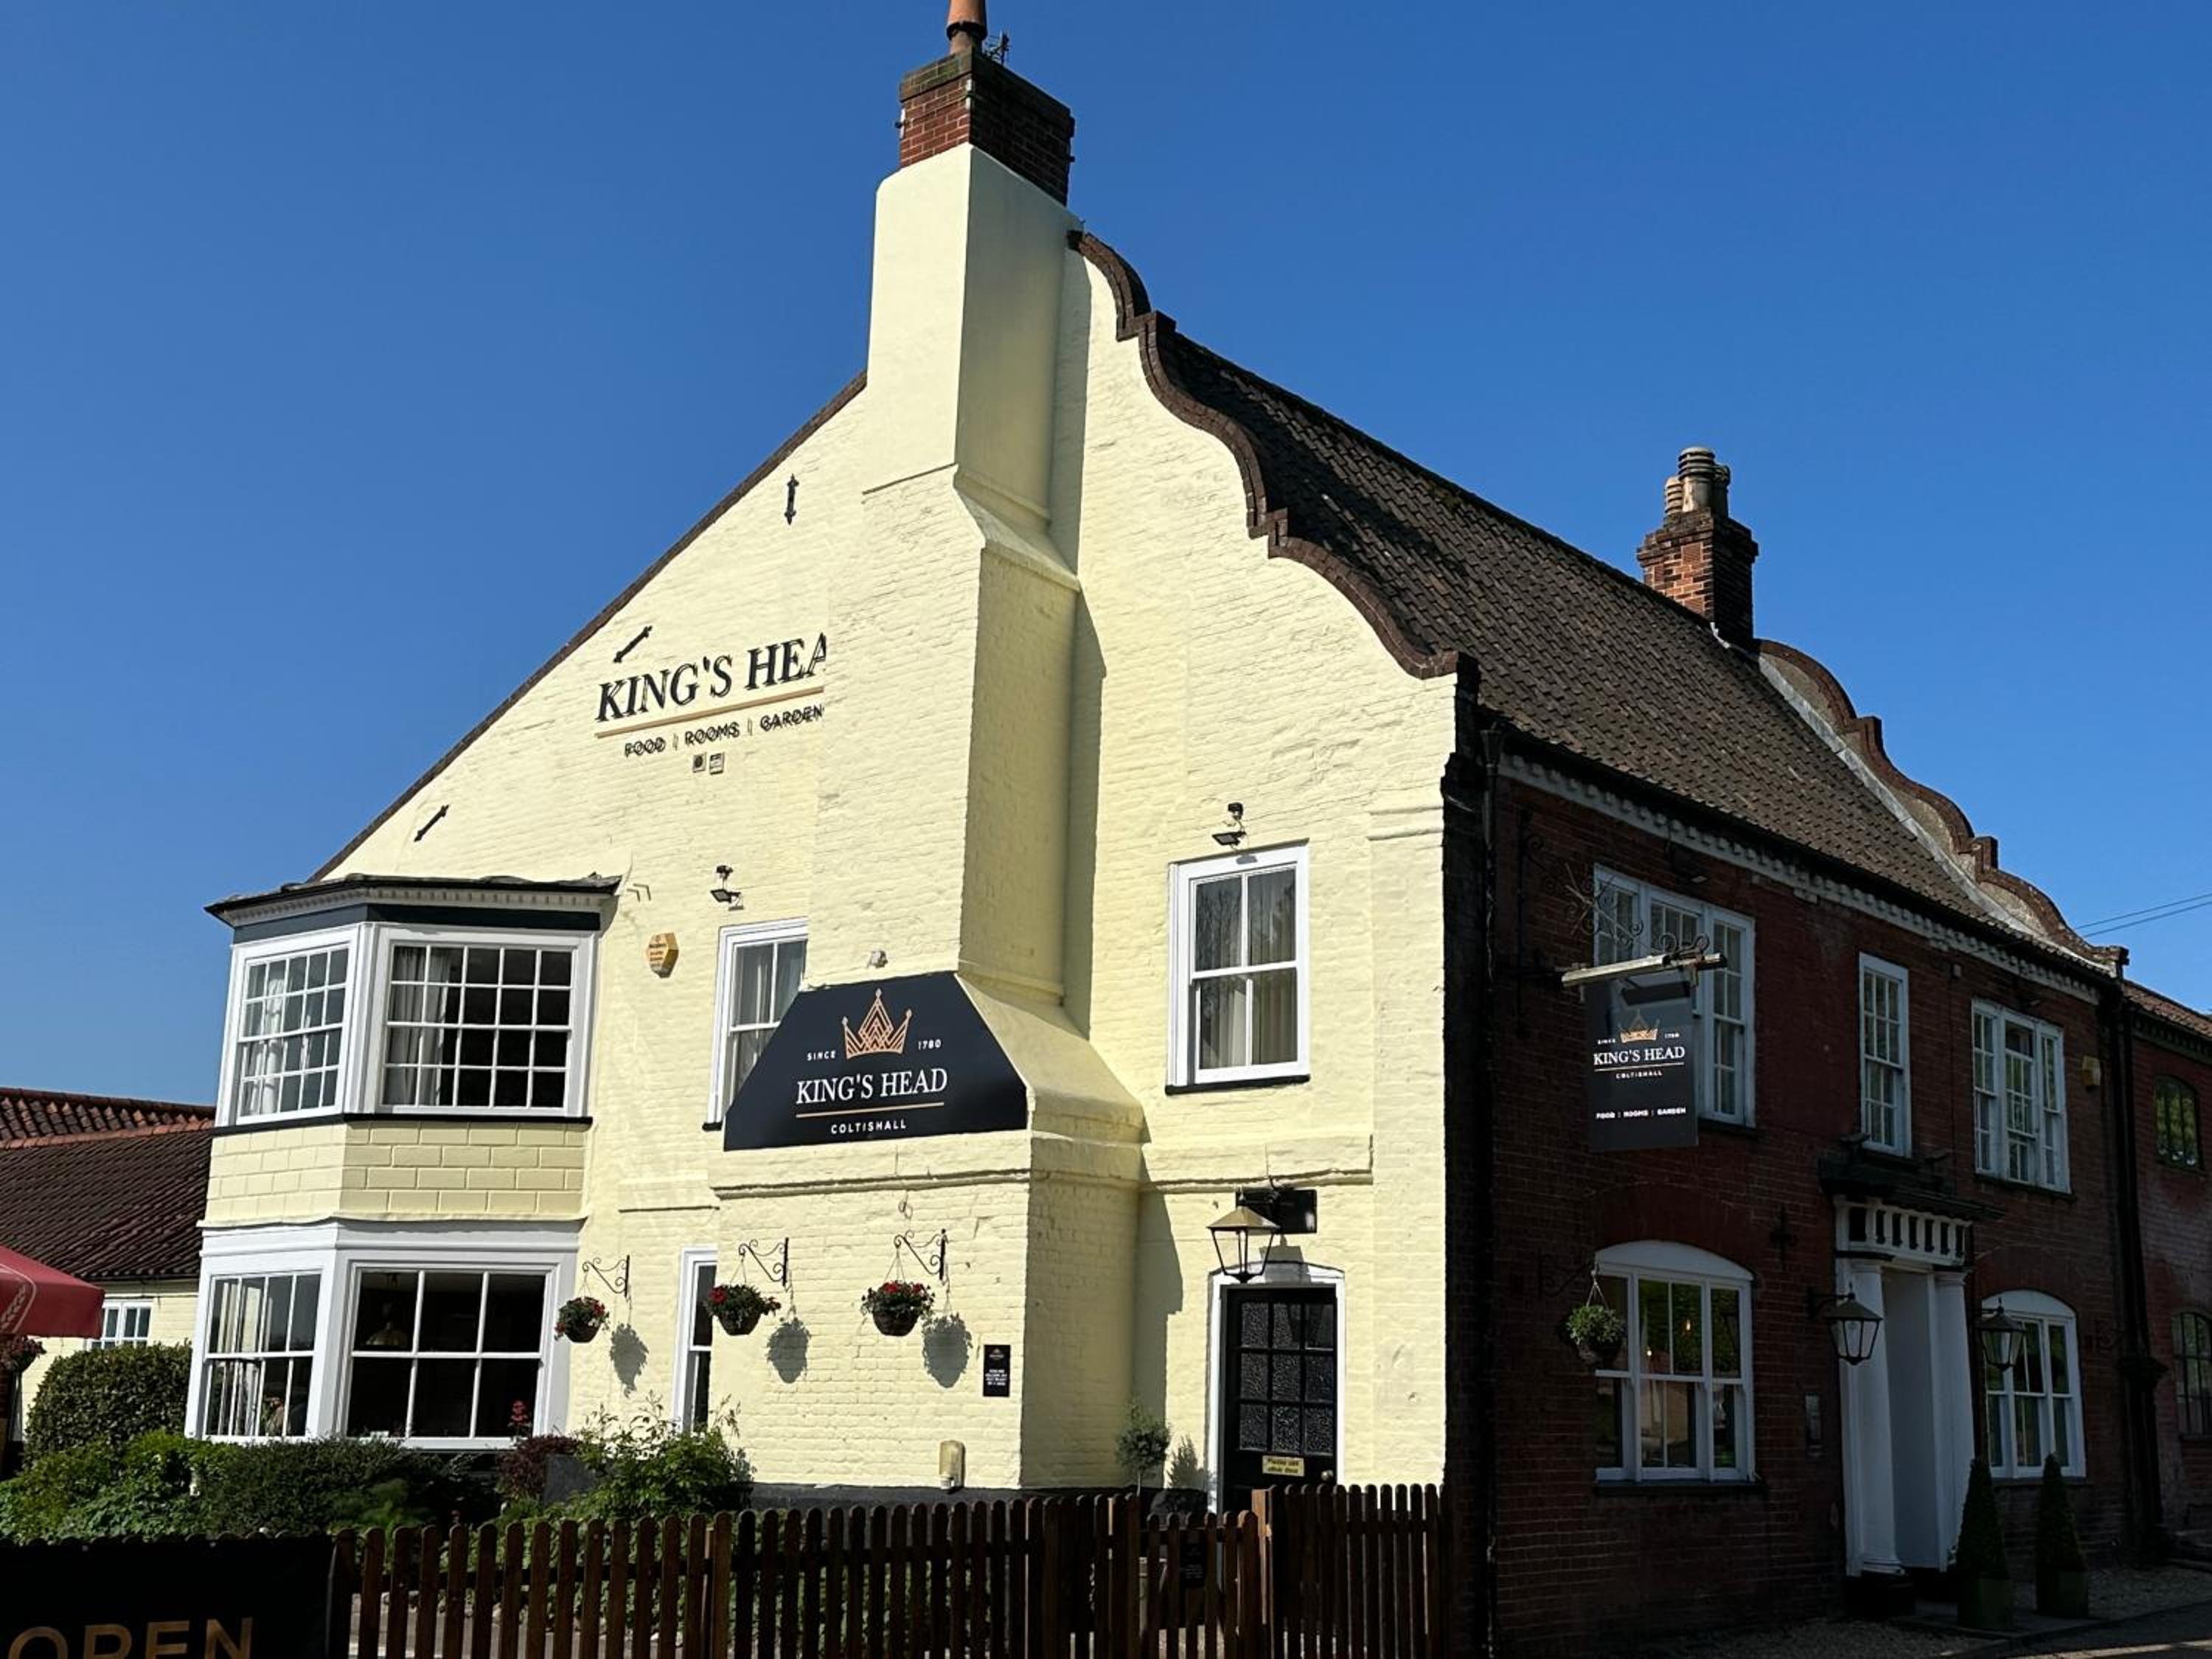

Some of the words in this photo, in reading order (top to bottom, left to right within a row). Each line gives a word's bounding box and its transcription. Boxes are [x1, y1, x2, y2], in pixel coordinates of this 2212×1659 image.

[594, 655, 734, 723] KING'S
[744, 632, 827, 690] HEA
[625, 737, 666, 757] FOOD
[684, 722, 740, 746] ROOMS
[917, 1038, 942, 1050] 1780
[807, 1050, 836, 1062] SINCE
[1593, 1049, 1641, 1066] KING'S
[1644, 1046, 1686, 1062] HEAD
[1615, 1070, 1663, 1079] COLTISHALL
[796, 1073, 873, 1105] KING'S
[880, 1068, 948, 1097] HEAD
[1596, 1111, 1615, 1119] FOOD
[1623, 1109, 1649, 1118] ROOMS
[1657, 1107, 1686, 1116] GARDEN
[830, 1119, 907, 1135] COLTISHALL
[8, 1616, 254, 1659] OPEN
